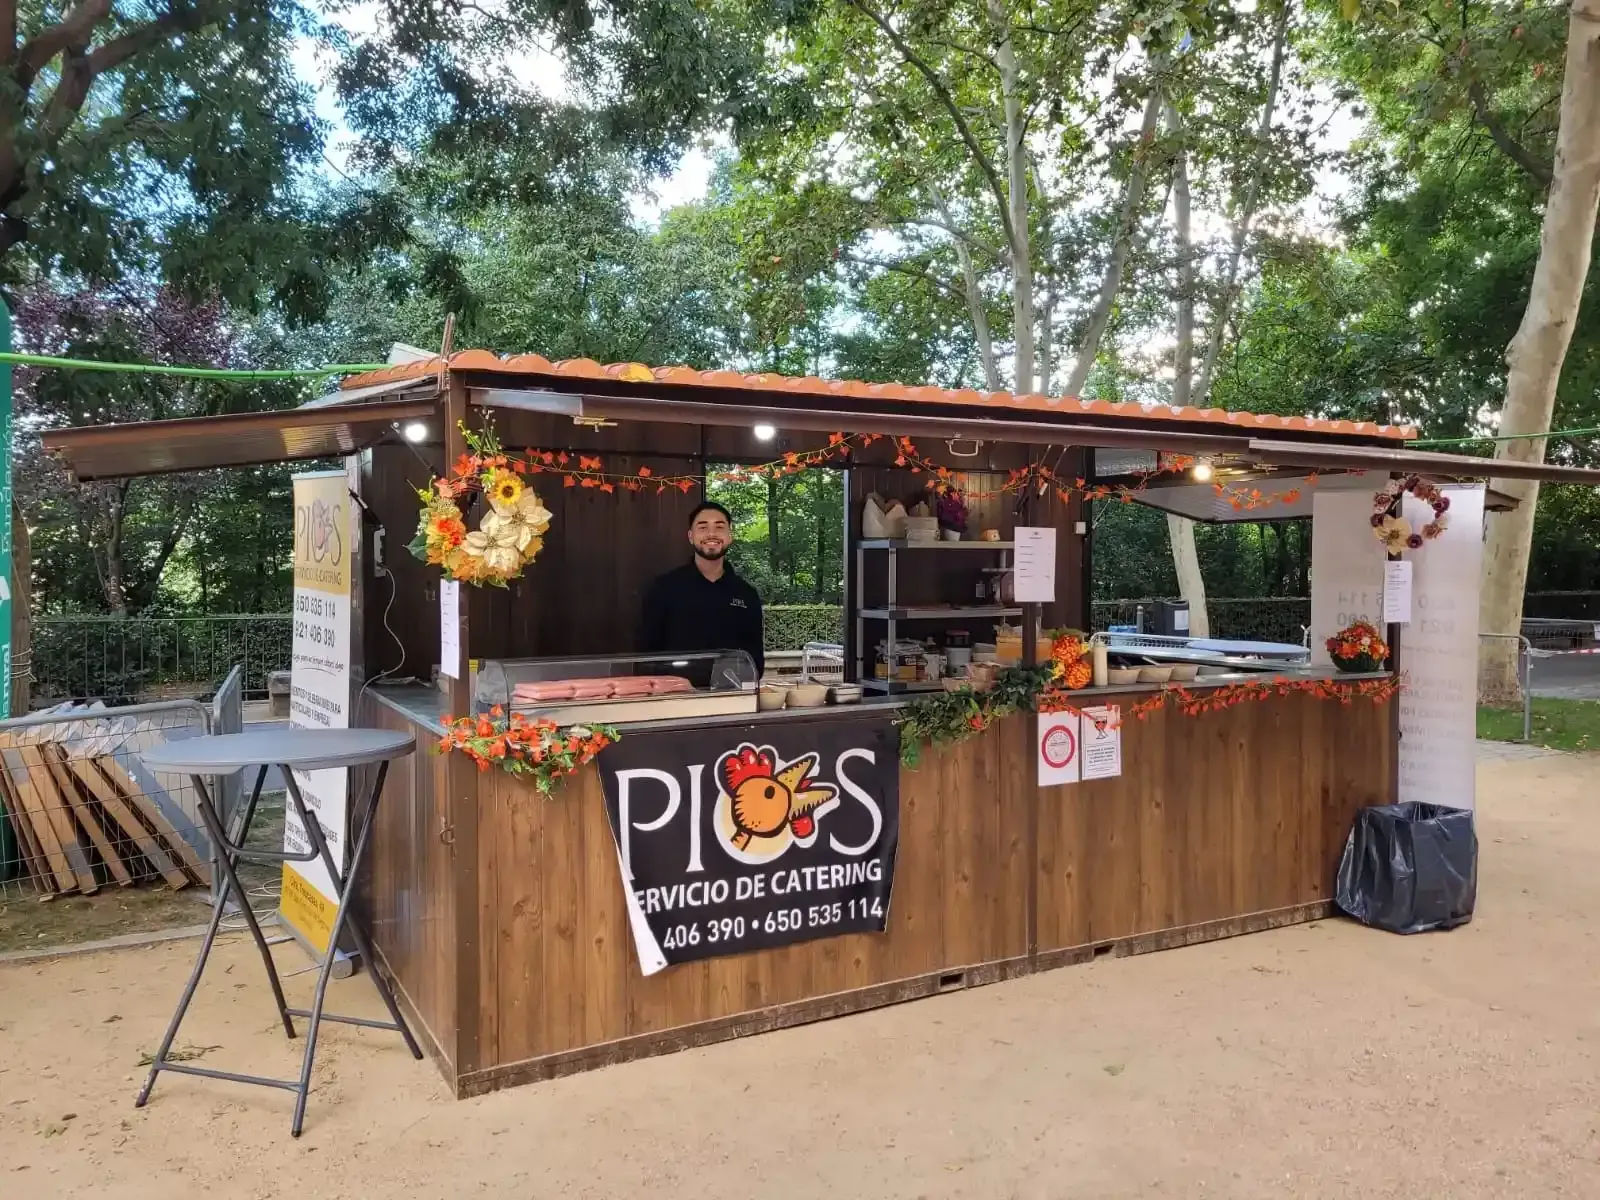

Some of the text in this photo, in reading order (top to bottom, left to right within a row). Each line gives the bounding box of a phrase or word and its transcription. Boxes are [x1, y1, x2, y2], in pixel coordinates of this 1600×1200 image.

[296, 499, 342, 567] PIOS
[325, 601, 336, 619] 114
[614, 742, 883, 880] PIOS
[634, 858, 882, 915] ERVICIO DE CATERING
[663, 896, 883, 950] 406 390 650 535 114
